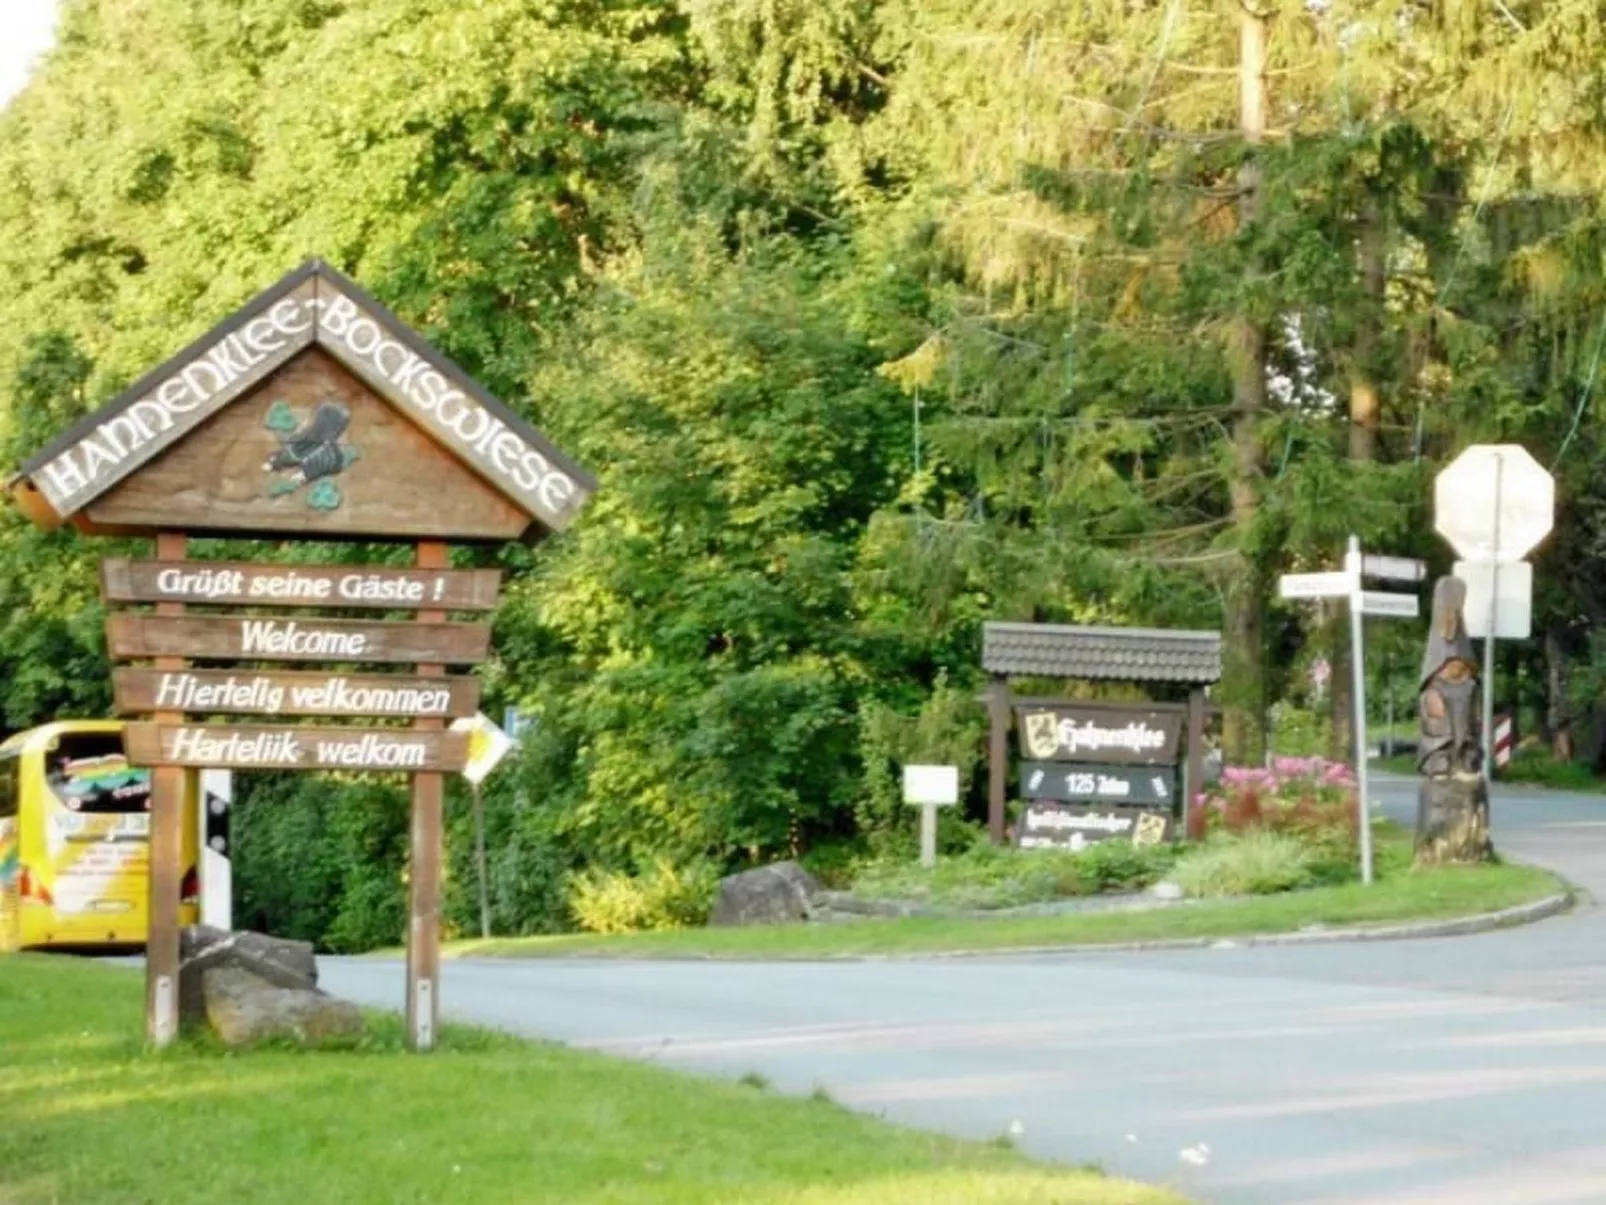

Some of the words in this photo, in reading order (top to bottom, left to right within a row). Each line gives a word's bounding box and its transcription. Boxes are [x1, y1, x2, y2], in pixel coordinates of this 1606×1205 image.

[320, 293, 576, 514] BOCKSWIESE
[156, 568, 244, 598] Grüßt
[249, 571, 331, 597] seine
[338, 574, 425, 601] Gäste
[433, 576, 446, 602] !
[240, 619, 365, 655] Welcome
[290, 678, 451, 712] velkommen
[315, 734, 427, 766] welkom
